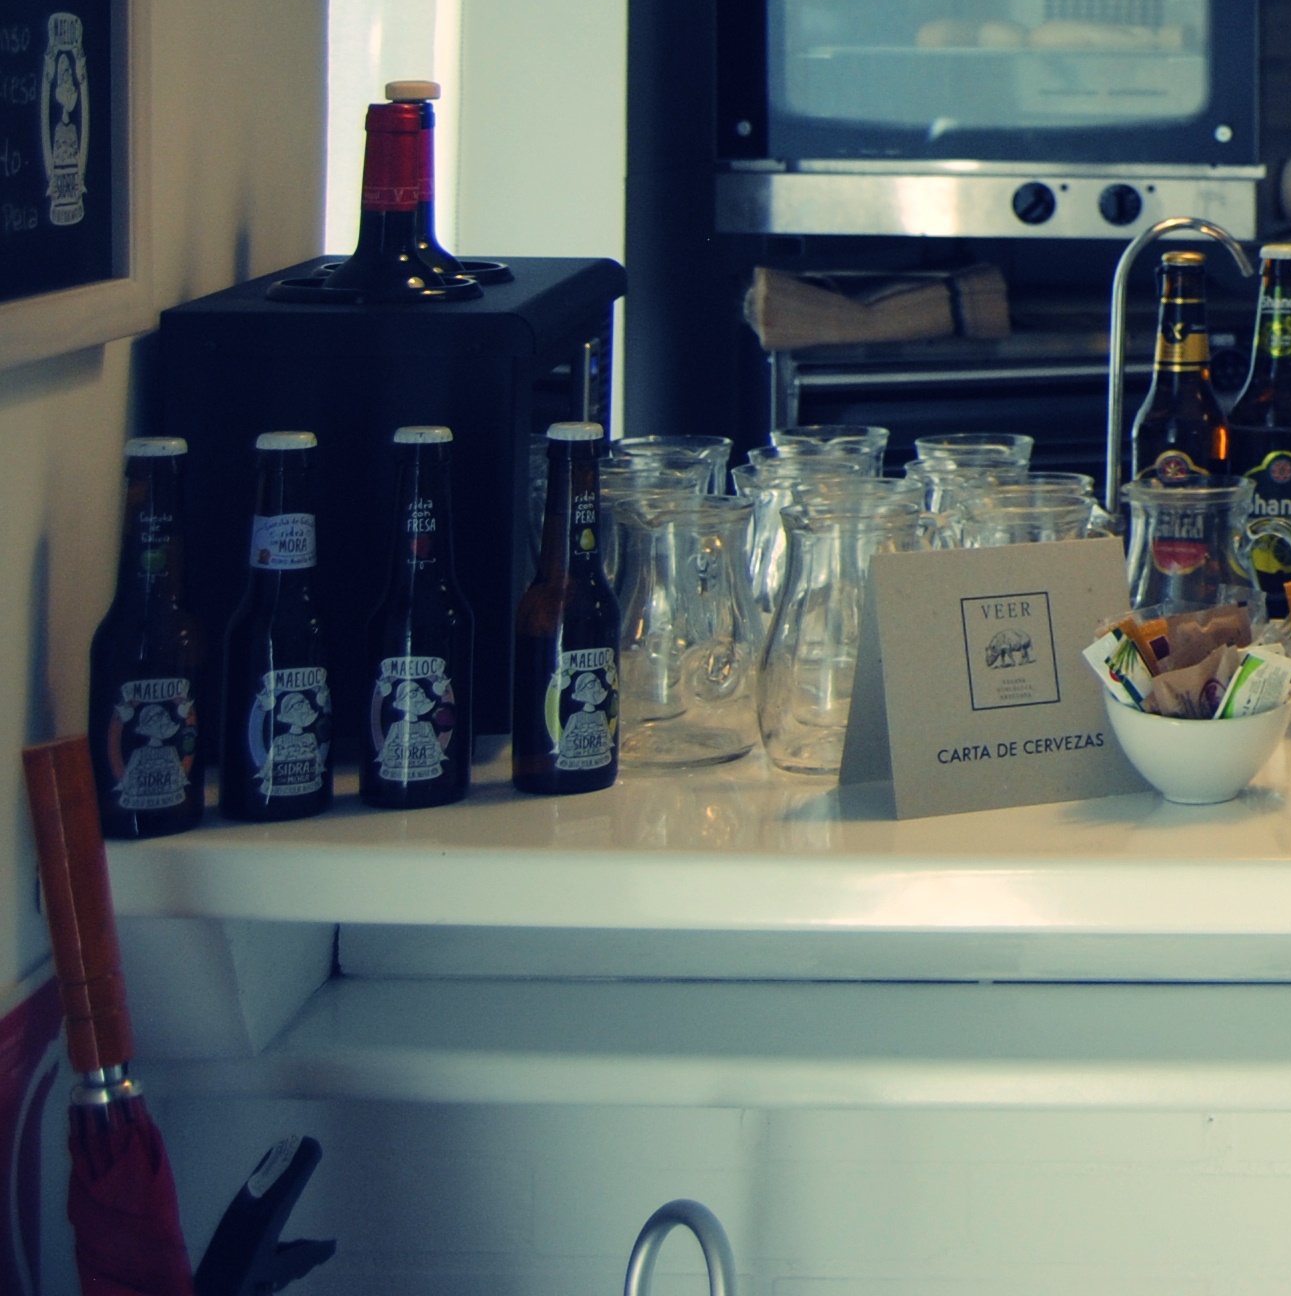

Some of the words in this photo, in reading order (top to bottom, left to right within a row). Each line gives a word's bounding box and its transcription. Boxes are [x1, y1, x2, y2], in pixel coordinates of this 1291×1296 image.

[407, 518, 436, 533] FRESA
[981, 601, 1032, 620] VEER
[276, 668, 323, 689] MAELOC
[133, 679, 185, 701] MAELOC
[573, 734, 602, 751] SIDRA
[937, 745, 992, 764] CARTA
[997, 741, 1017, 758] DE
[1023, 732, 1105, 755] CERVEZAS
[277, 761, 310, 776] SIDRA
